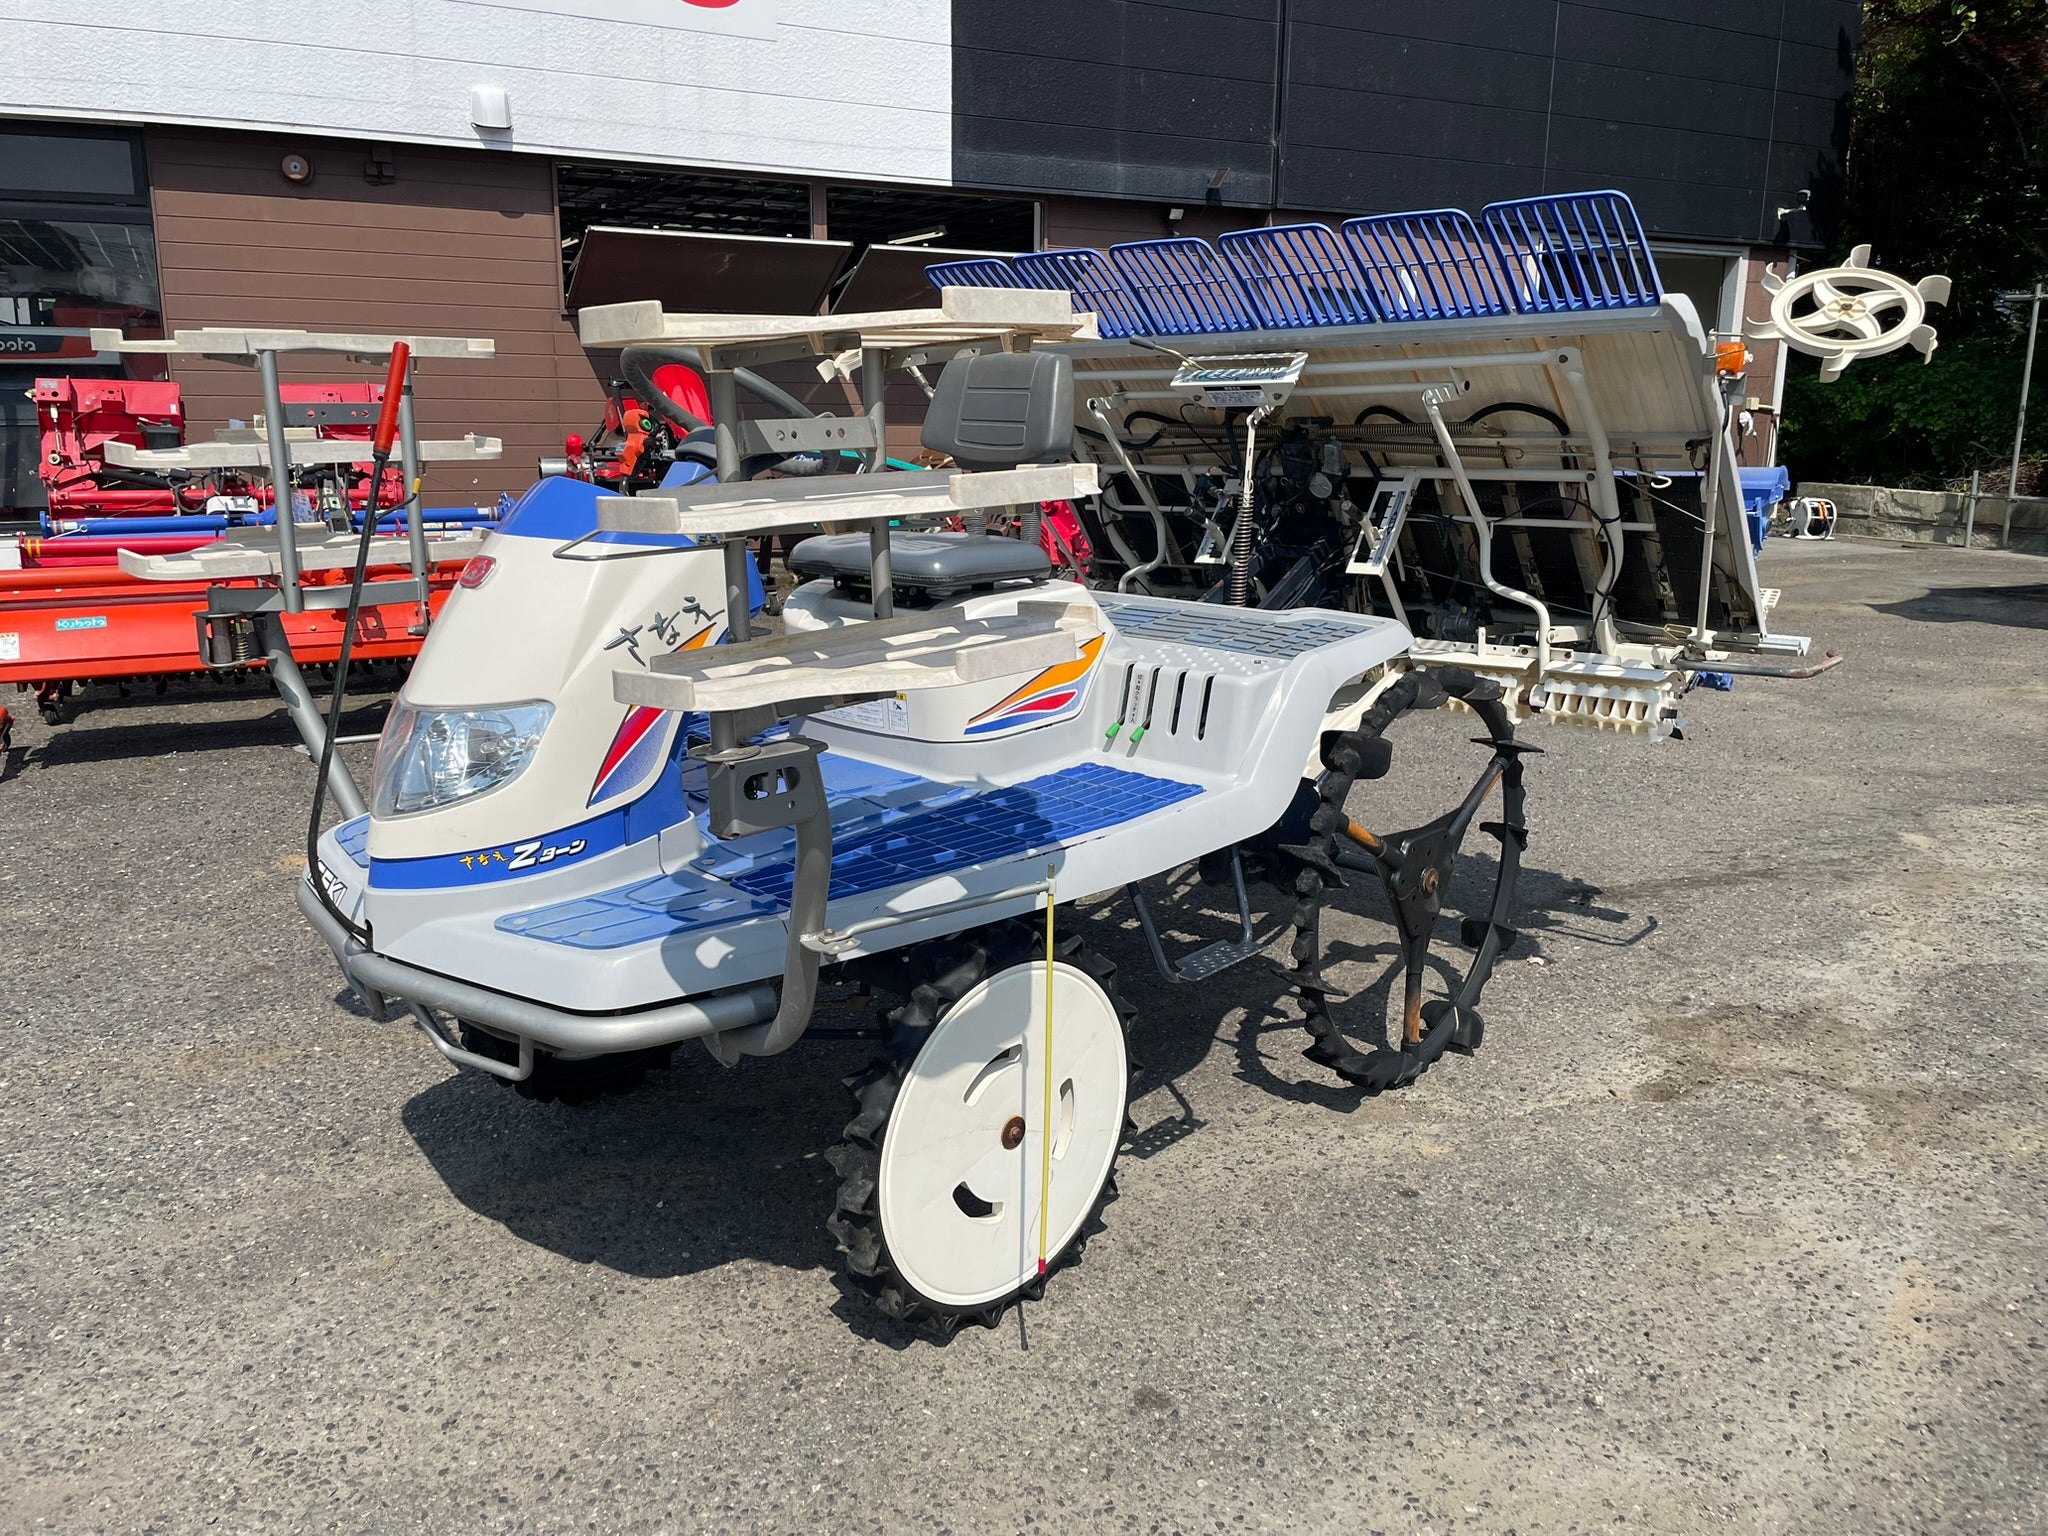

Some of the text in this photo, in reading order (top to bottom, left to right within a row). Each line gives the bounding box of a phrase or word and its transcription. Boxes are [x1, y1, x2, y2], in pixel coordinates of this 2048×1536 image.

[56, 617, 106, 630] Kubota
[603, 596, 726, 668] さなえ
